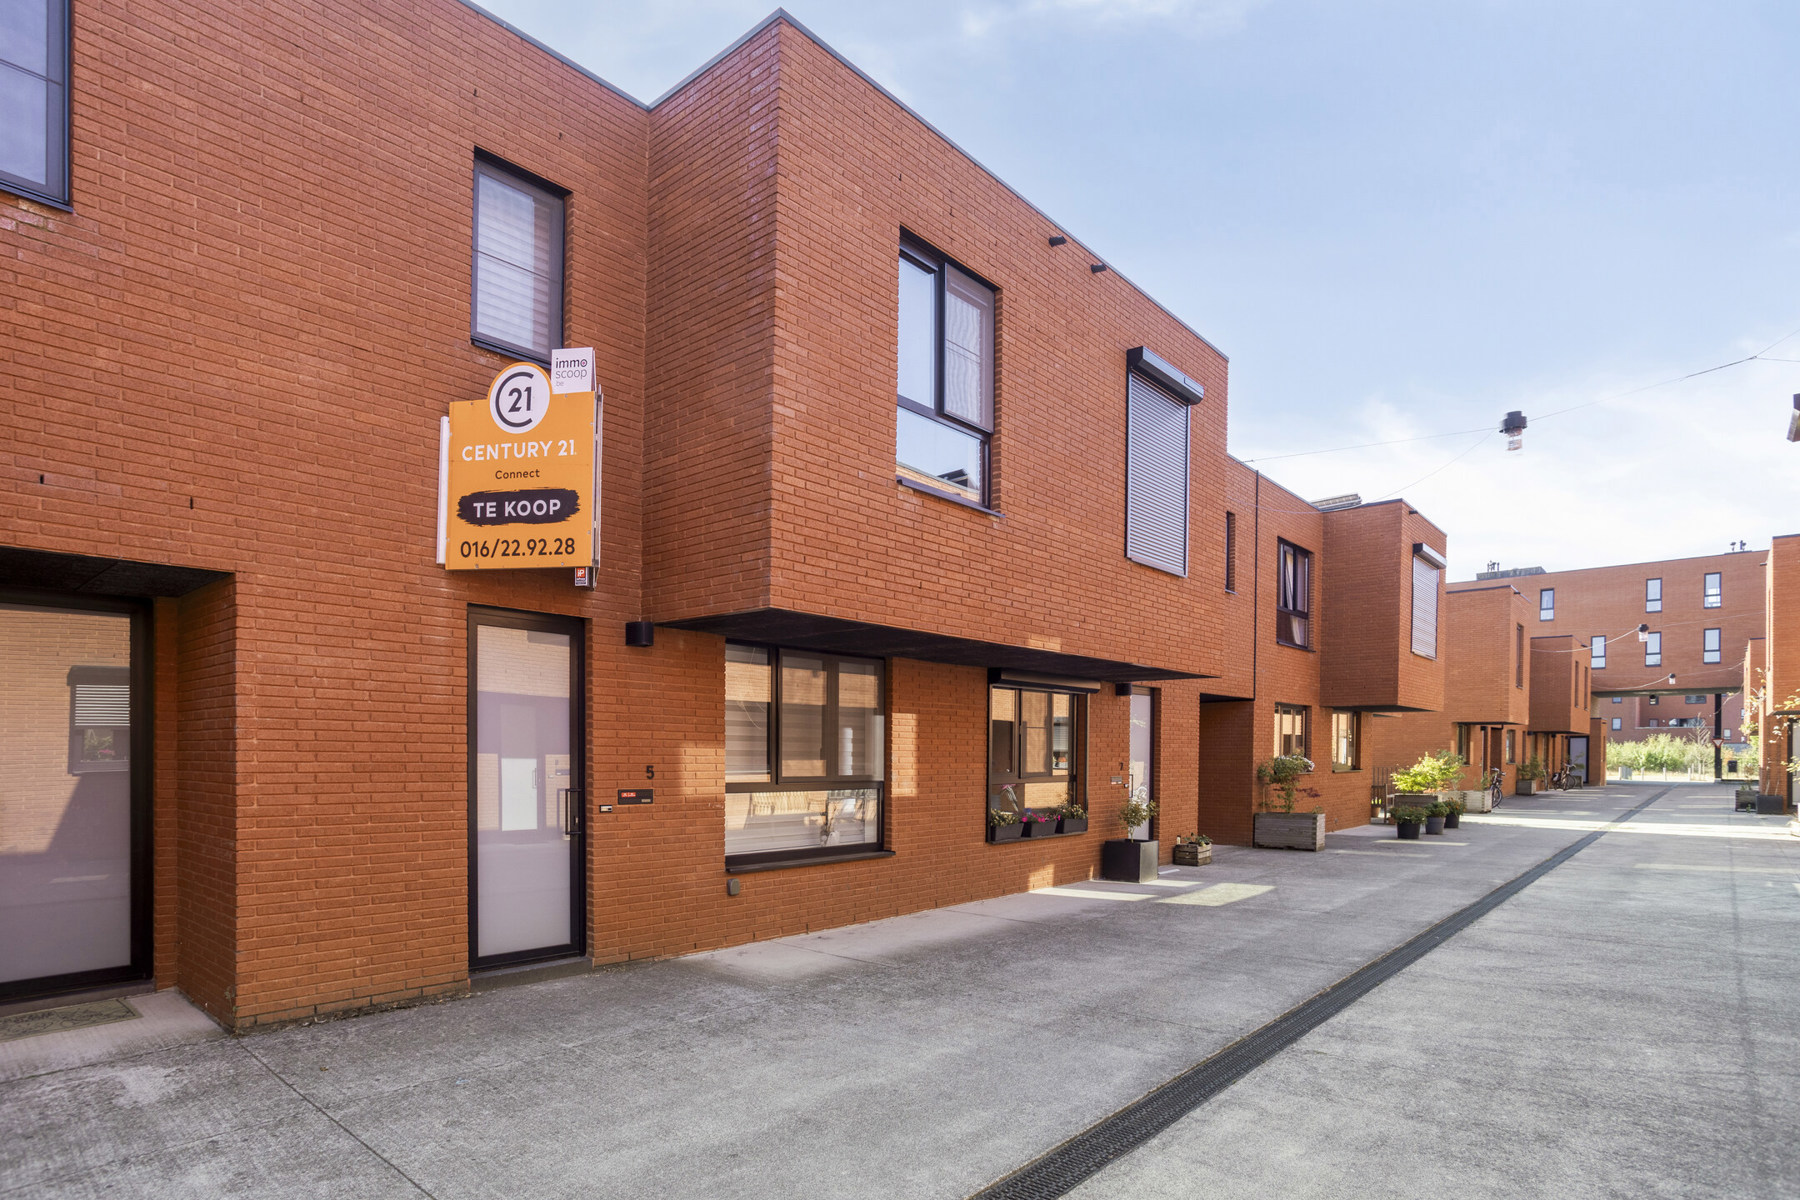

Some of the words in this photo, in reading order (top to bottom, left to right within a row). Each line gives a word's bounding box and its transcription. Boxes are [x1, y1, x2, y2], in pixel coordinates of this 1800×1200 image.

[555, 358, 588, 368] immo
[555, 369, 588, 380] scoop
[462, 440, 553, 461] CENTURY
[557, 439, 576, 456] 21
[495, 469, 540, 480] Connect
[473, 501, 497, 518] TE
[504, 499, 561, 517] KOOP
[460, 537, 576, 558] 016/22.92.28
[646, 765, 655, 780] 5
